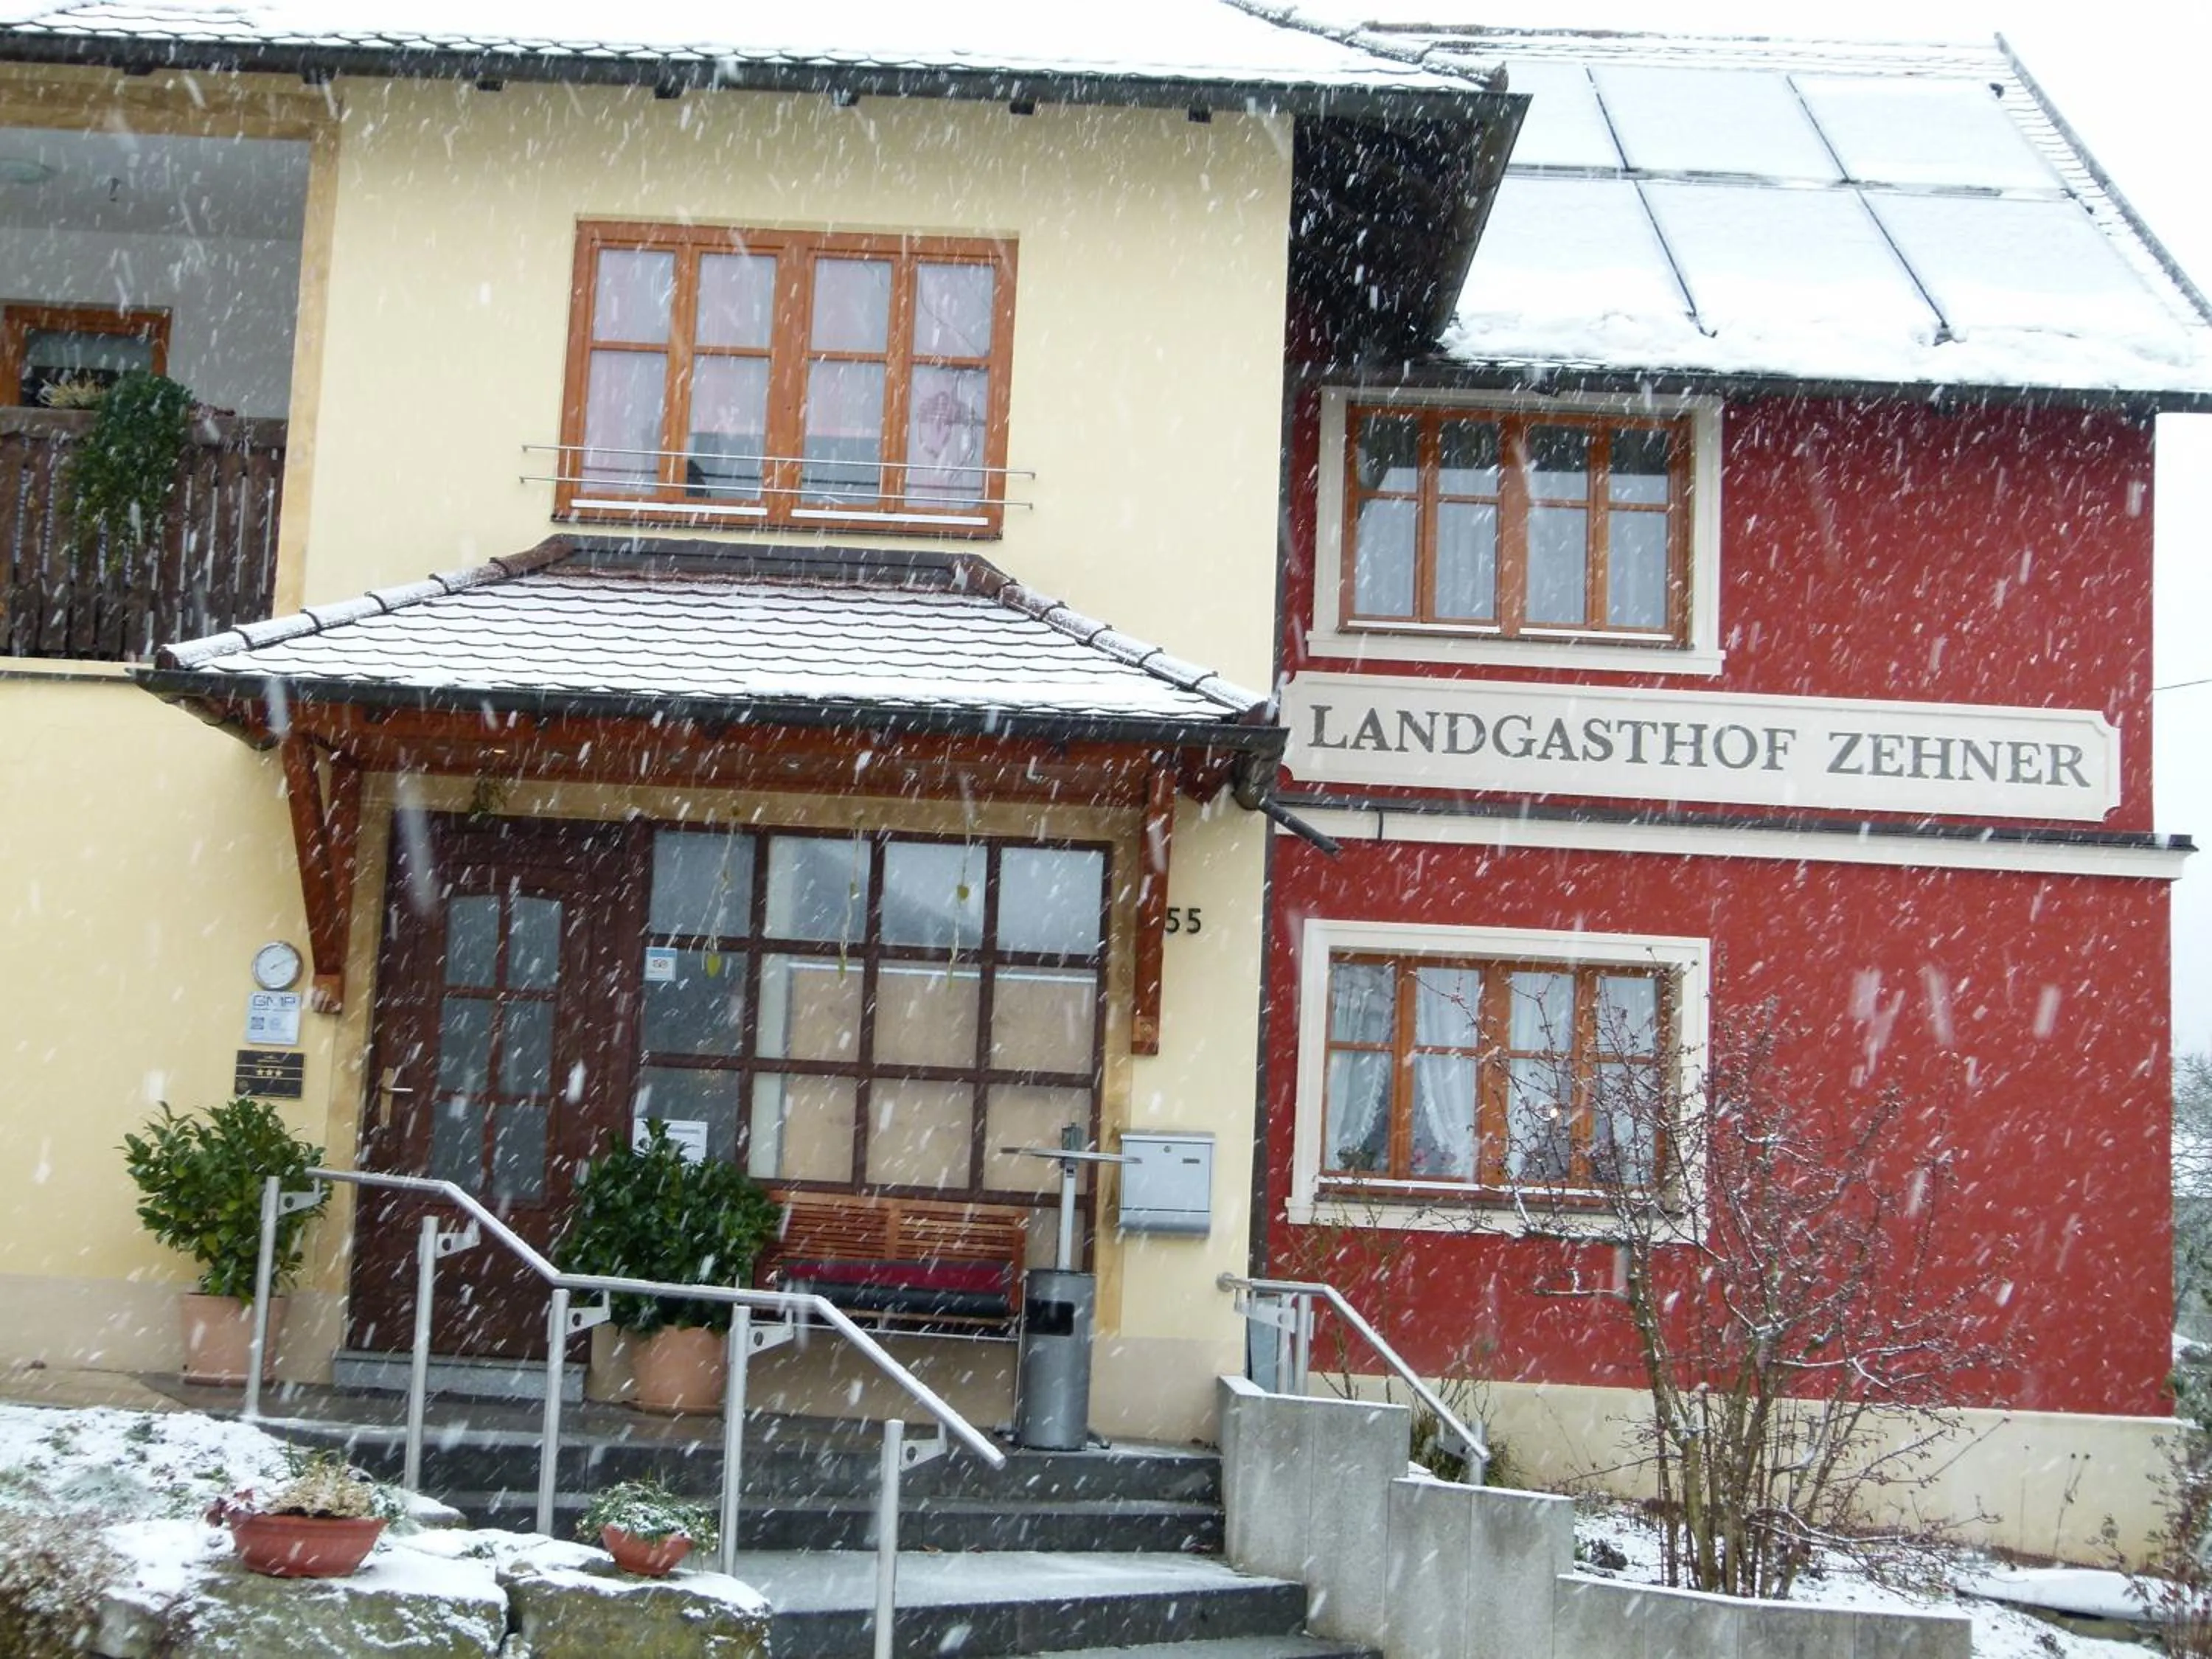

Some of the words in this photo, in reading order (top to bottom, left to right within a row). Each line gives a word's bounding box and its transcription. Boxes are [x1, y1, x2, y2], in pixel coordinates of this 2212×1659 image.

[1307, 705, 1796, 771] LANDGASTHOF
[1826, 731, 2091, 787] ZEHNER
[1166, 907, 1201, 934] 55
